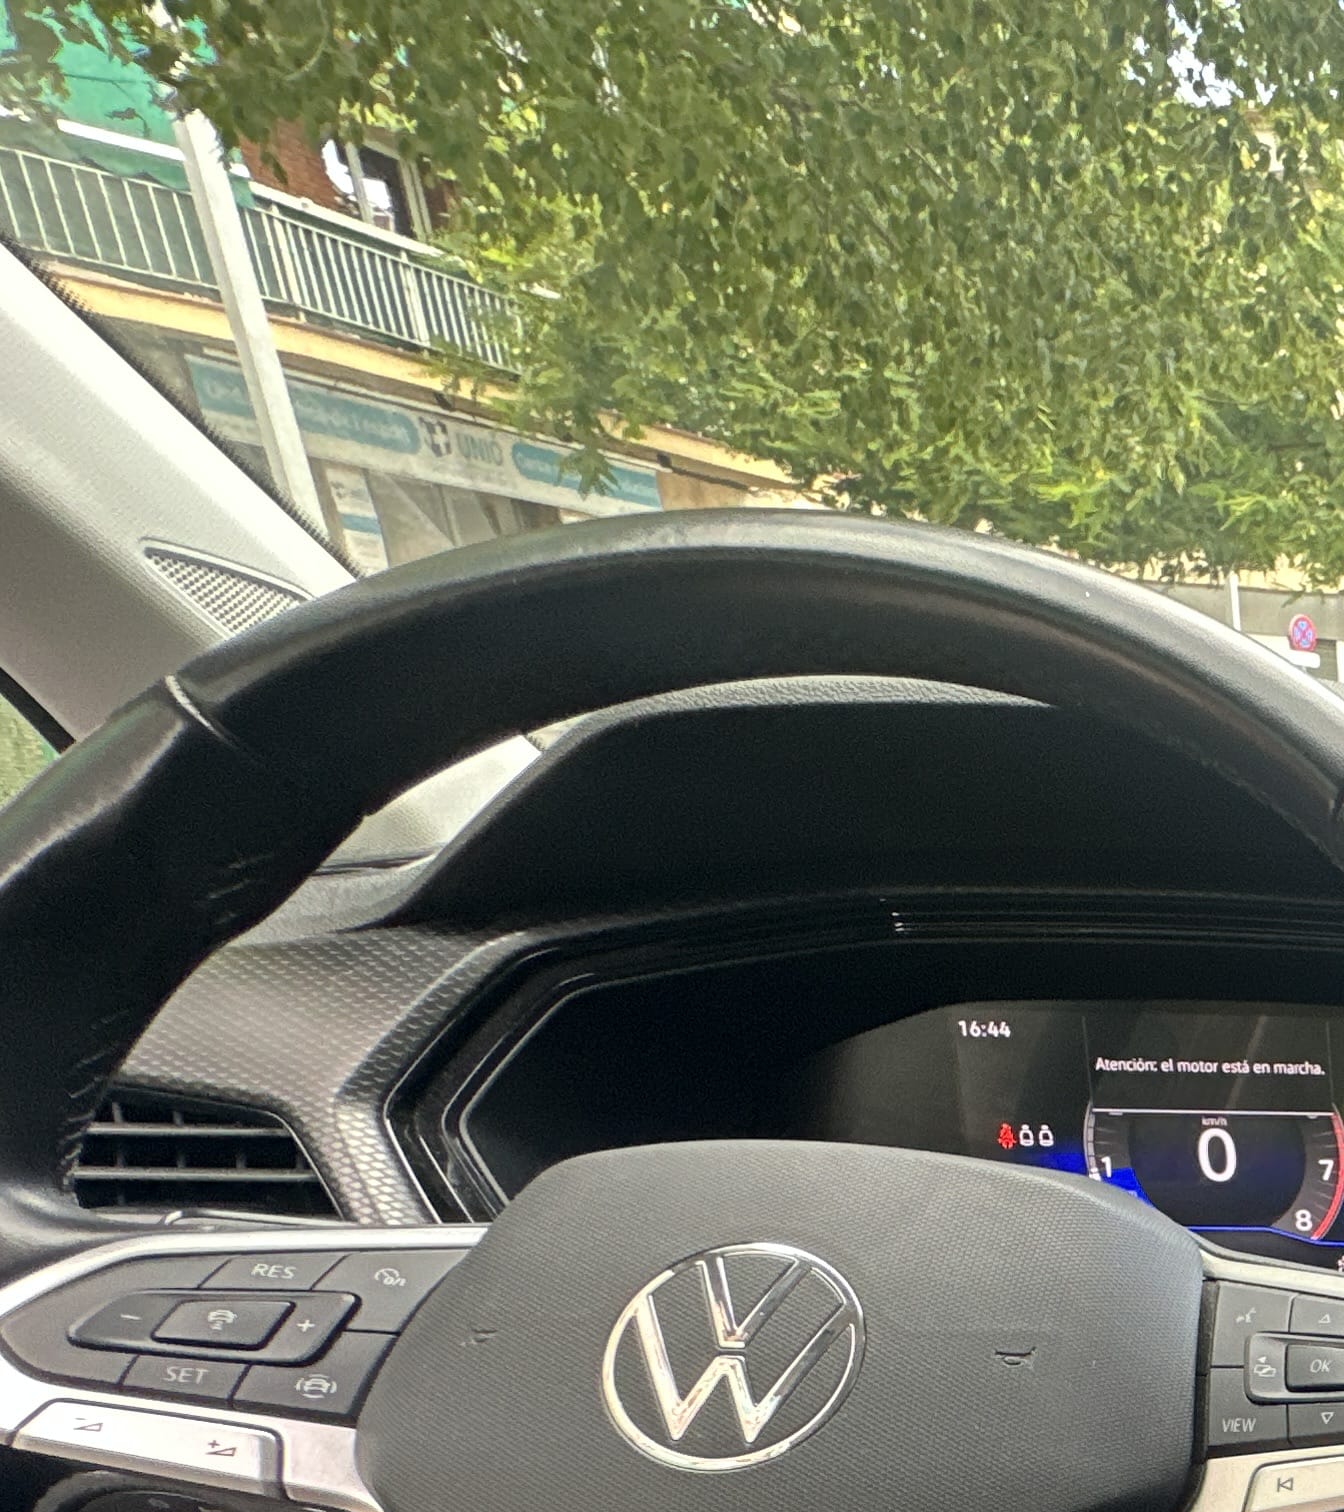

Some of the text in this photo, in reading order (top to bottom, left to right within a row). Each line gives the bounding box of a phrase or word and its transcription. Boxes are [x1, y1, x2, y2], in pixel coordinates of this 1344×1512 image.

[958, 1020, 1011, 1039] 16:44
[1095, 1057, 1325, 1076] Atención: el motor está en marcha.
[1201, 1116, 1228, 1126] km/h
[1198, 1128, 1237, 1182] 0
[1101, 1156, 1112, 1178] 1
[1318, 1159, 1334, 1181] 7
[1295, 1209, 1313, 1231] 8
[251, 1263, 298, 1280] RES
[1310, 1358, 1332, 1373] OK
[162, 1366, 207, 1385] SET
[1221, 1417, 1257, 1433] VIEW
